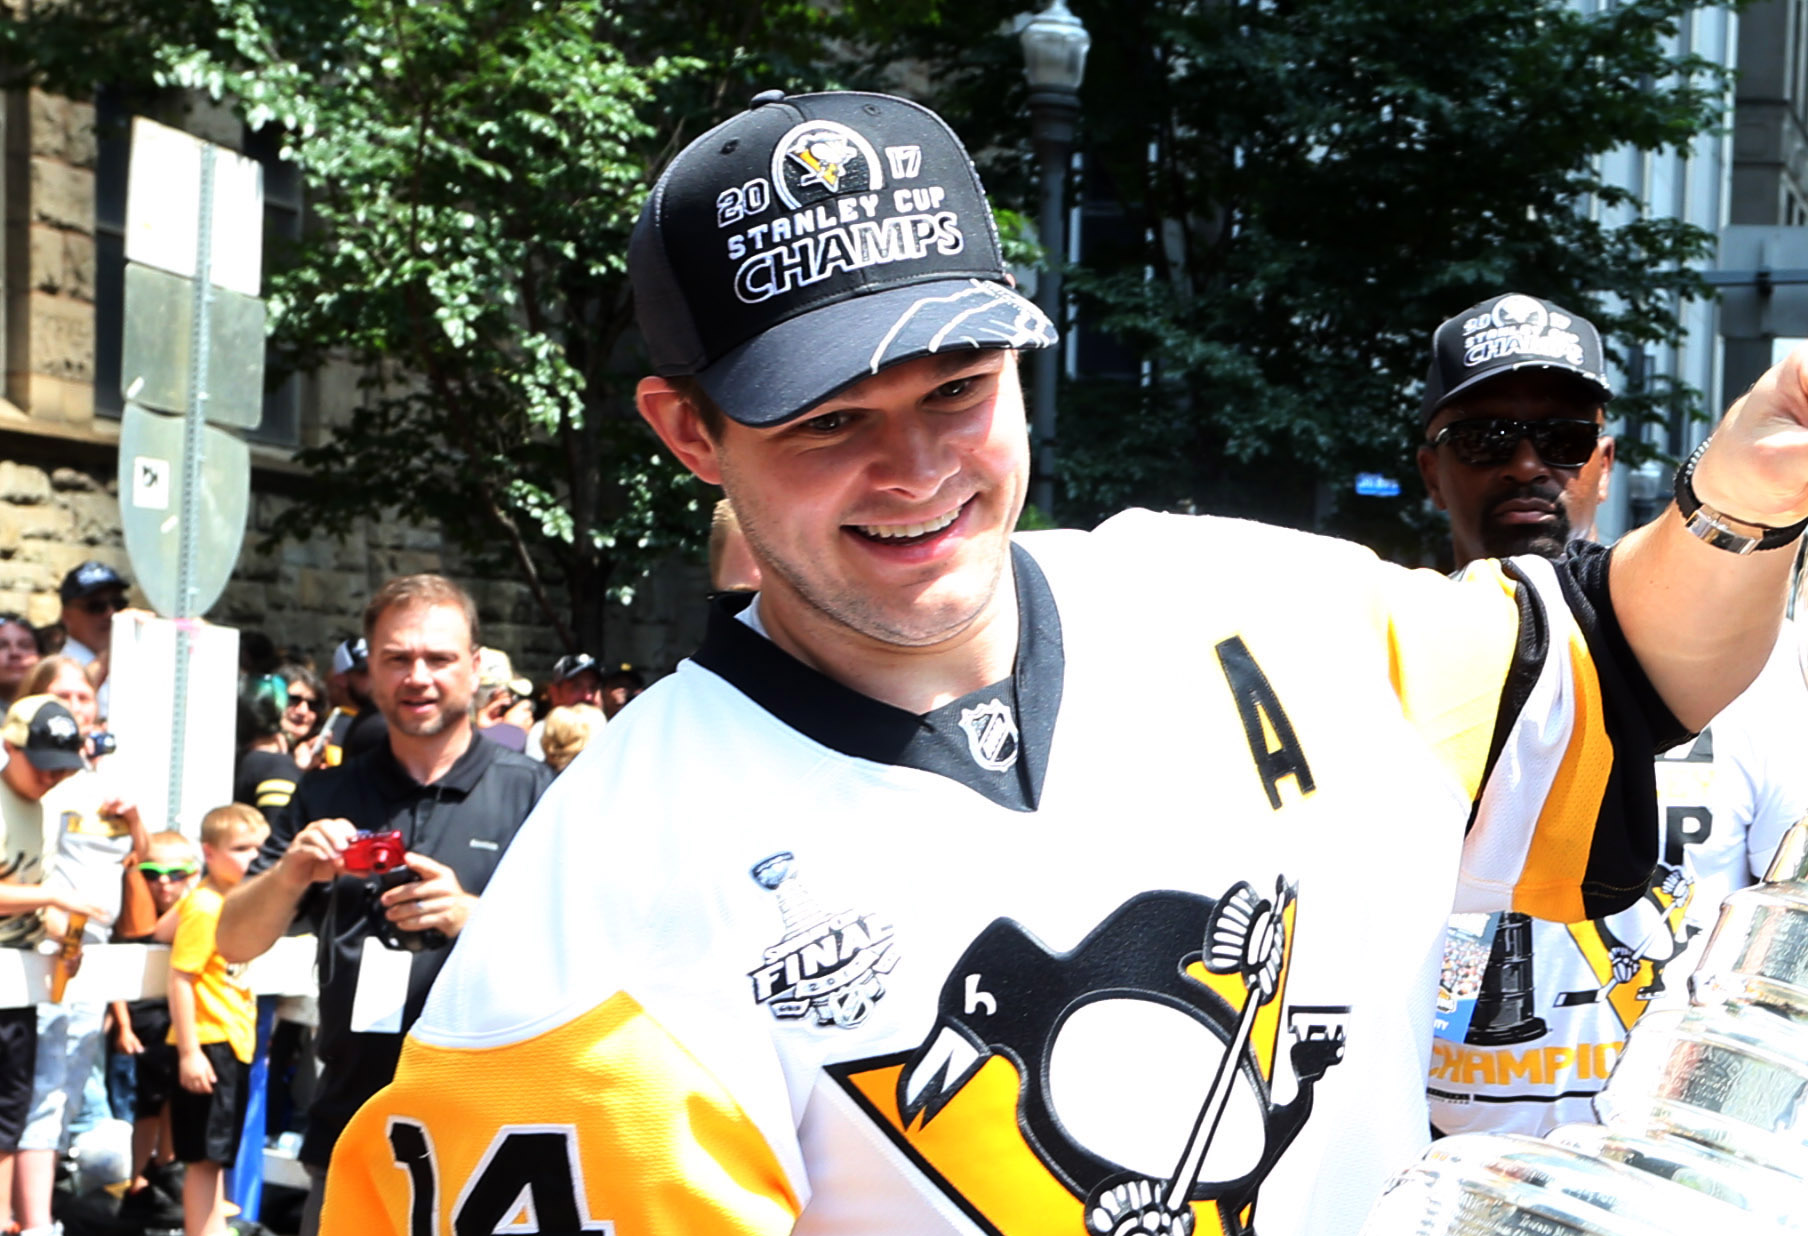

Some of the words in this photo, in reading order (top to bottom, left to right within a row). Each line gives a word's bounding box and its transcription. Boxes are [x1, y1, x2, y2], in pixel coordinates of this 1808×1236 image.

[716, 178, 771, 228] 20
[884, 145, 923, 180] 17
[728, 192, 880, 261] STANLEY
[895, 186, 946, 214] CUP
[734, 210, 965, 304] CHAMPS
[1213, 633, 1317, 813] A
